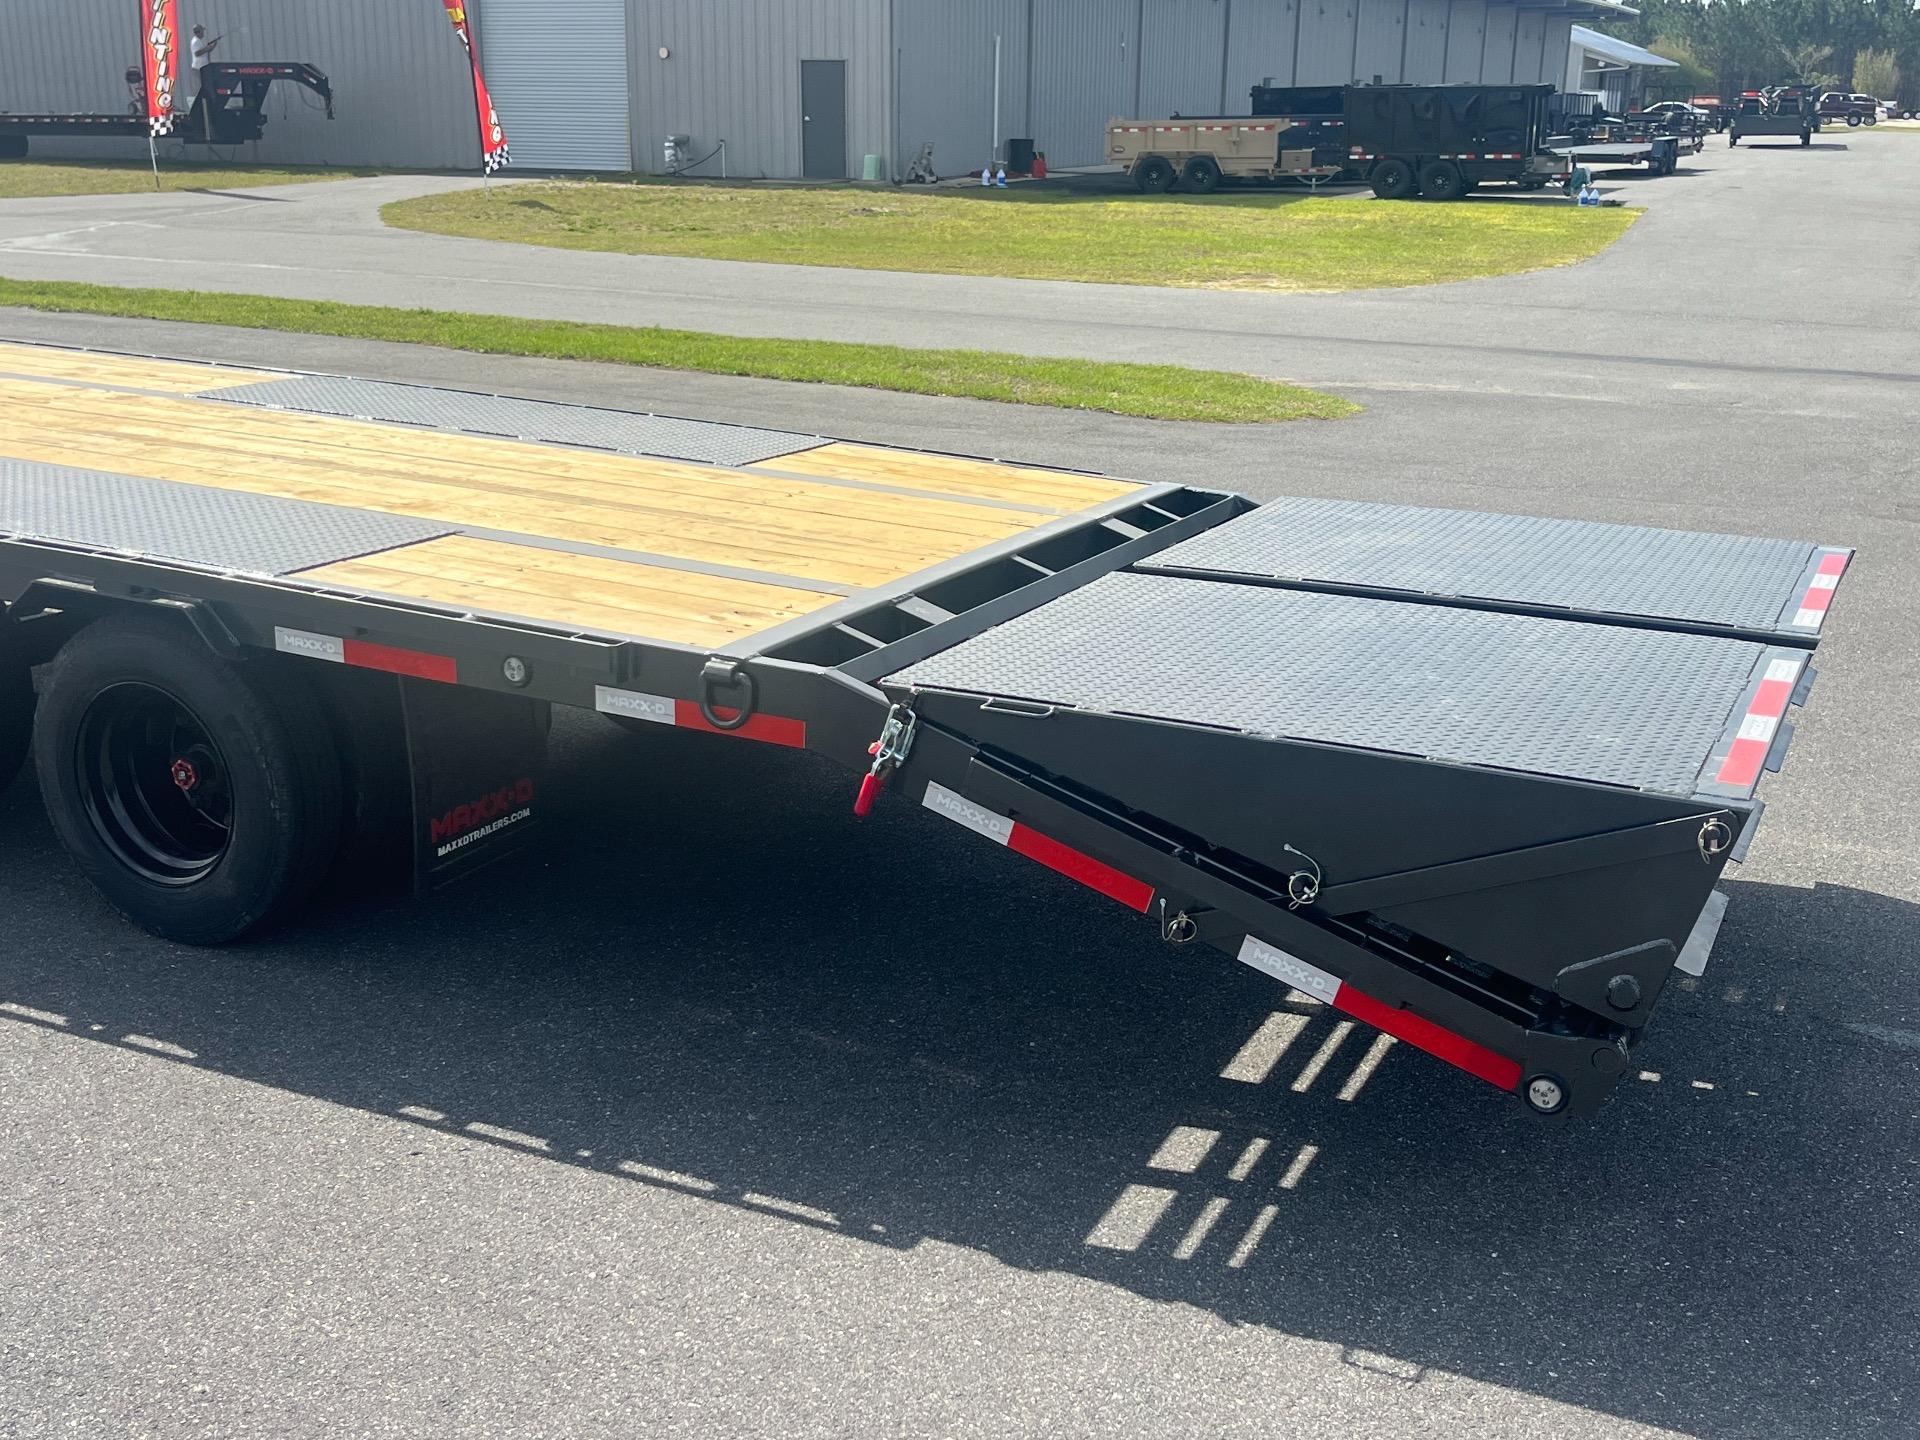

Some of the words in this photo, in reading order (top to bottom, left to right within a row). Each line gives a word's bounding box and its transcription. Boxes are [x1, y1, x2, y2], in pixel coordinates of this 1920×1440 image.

[284, 634, 336, 653] MAXX-D
[607, 694, 666, 714] MAXX-D
[936, 792, 1000, 831] MAXX-D
[437, 807, 531, 857] MAXXDTRAILERS.COM
[1252, 948, 1326, 990] MAXX-D
